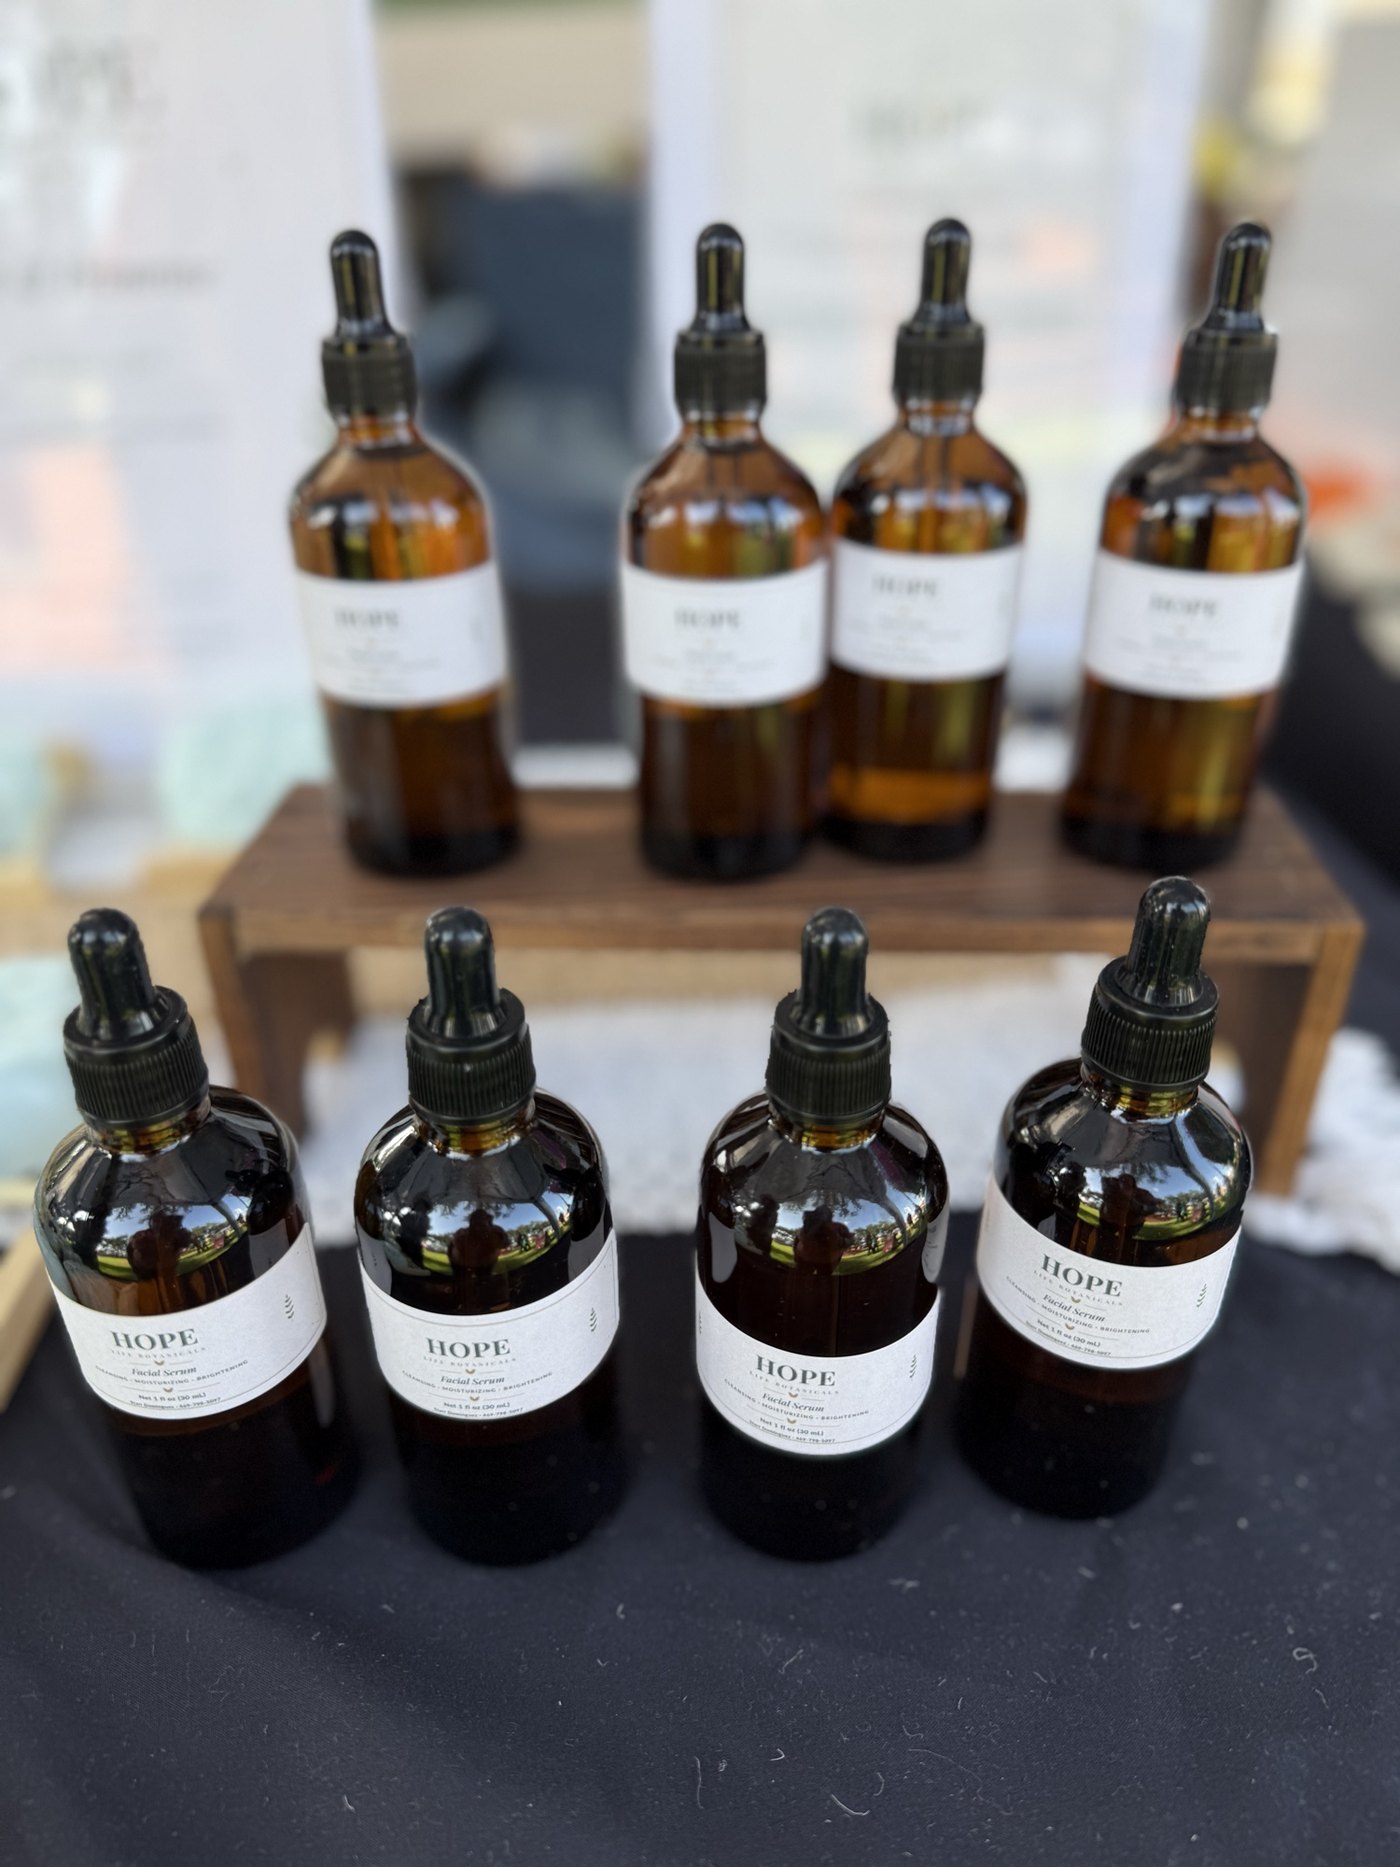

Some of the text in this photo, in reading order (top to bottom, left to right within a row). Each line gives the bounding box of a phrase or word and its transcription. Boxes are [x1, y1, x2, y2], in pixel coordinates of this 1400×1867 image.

[1041, 1254, 1123, 1297] HOPE
[1041, 1304, 1093, 1329] MOISTURIZING
[1043, 1294, 1106, 1322] Facial Serum
[111, 1329, 198, 1350] HOPE
[426, 1338, 511, 1358] HOPE
[132, 1367, 197, 1376] Facial Serum
[197, 1360, 248, 1381] BRIGHTENING
[440, 1376, 505, 1385] Facial Serum
[756, 1355, 836, 1386] HOPE
[504, 1372, 553, 1391] BRIGHTENING
[762, 1393, 824, 1412] Facial Serum
[762, 1402, 814, 1420] MOISTURIZING
[821, 1410, 869, 1420] BRIGHTENING
